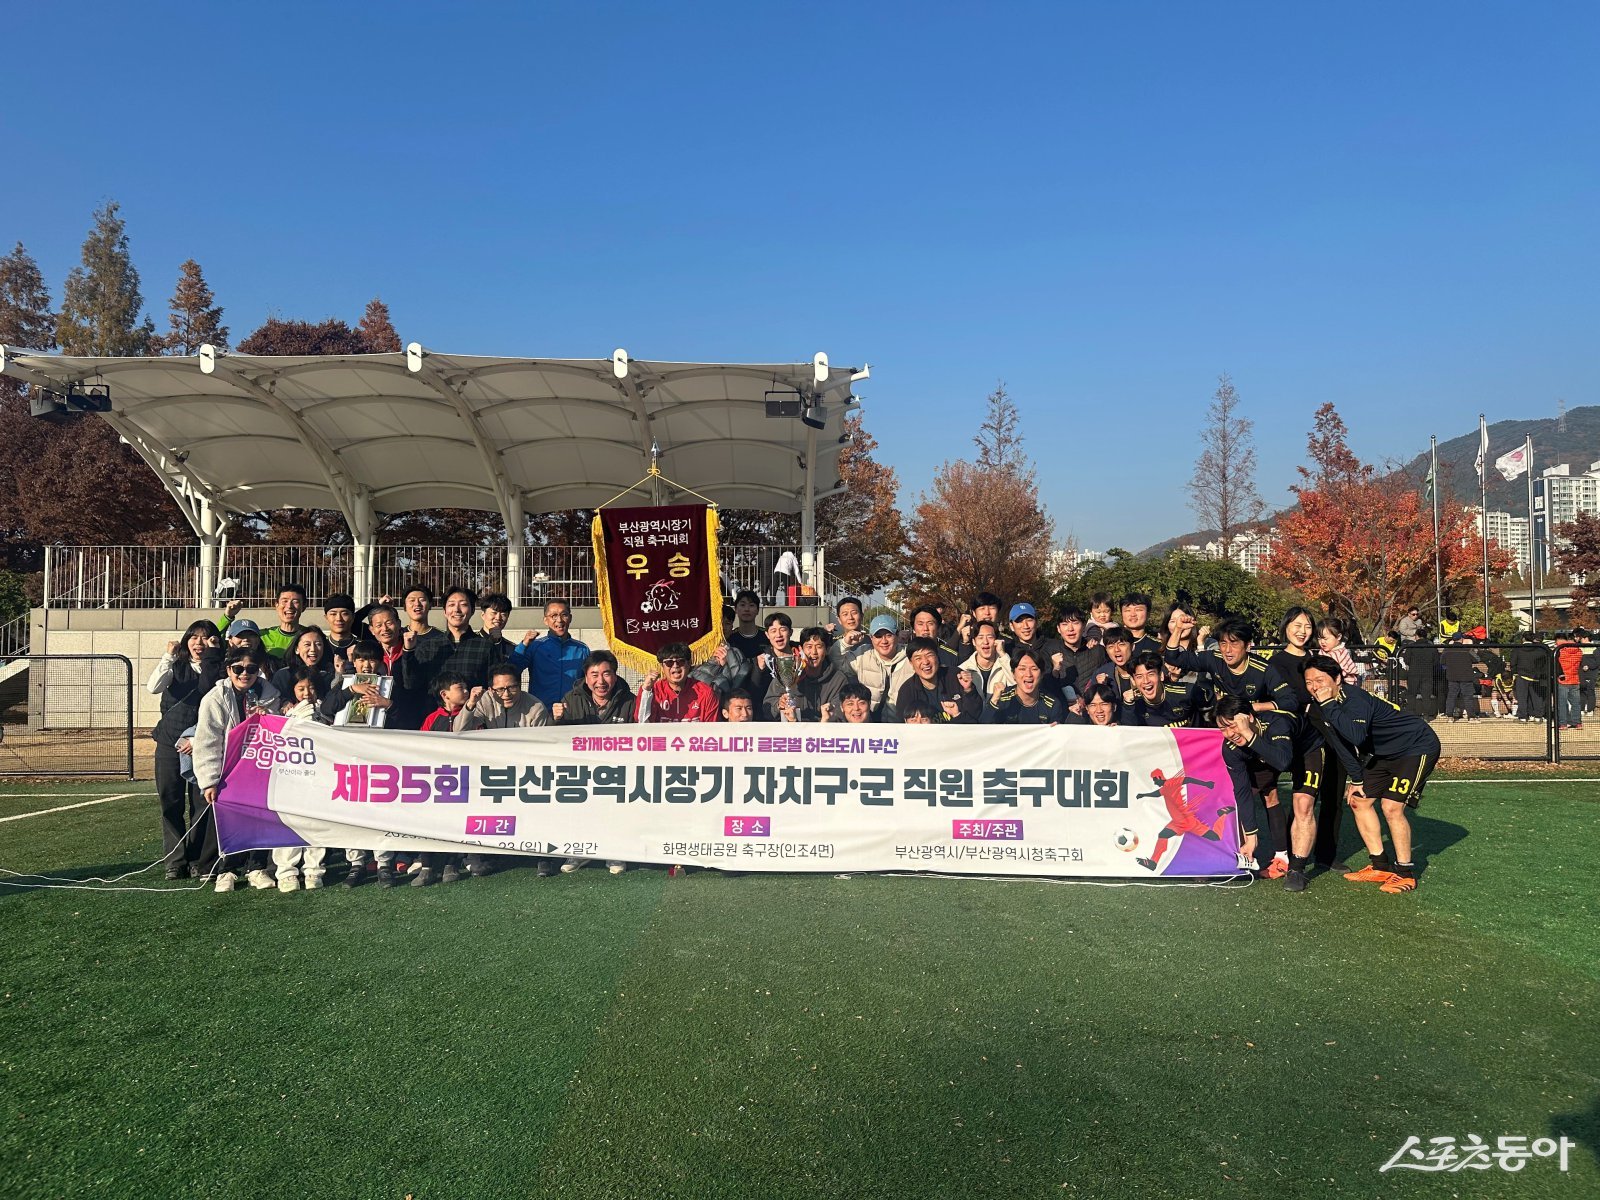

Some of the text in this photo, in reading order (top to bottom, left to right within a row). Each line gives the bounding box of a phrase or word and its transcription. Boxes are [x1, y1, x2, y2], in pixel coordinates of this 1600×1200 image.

[619, 518, 692, 534] 부산광역시장기
[623, 533, 689, 548] 직원 축구대회
[641, 617, 699, 632] 부산광역시장
[243, 724, 314, 750] Busan
[572, 736, 899, 754] 함께하면 이룰 수 있습니다! 글로벌 허브도시 부산
[256, 746, 317, 770] good
[331, 763, 1129, 808] 제35회 부산광역시장기 자치구·군 직원 축구대회
[1304, 770, 1319, 789] 11
[1388, 776, 1411, 795] 13
[959, 823, 1018, 838] 주최/주관
[563, 842, 599, 855] 2일간
[662, 842, 834, 858] 화명생태공원 축구장(인조4면)
[895, 845, 1084, 862] 부산광역시/부산광역시청축구회
